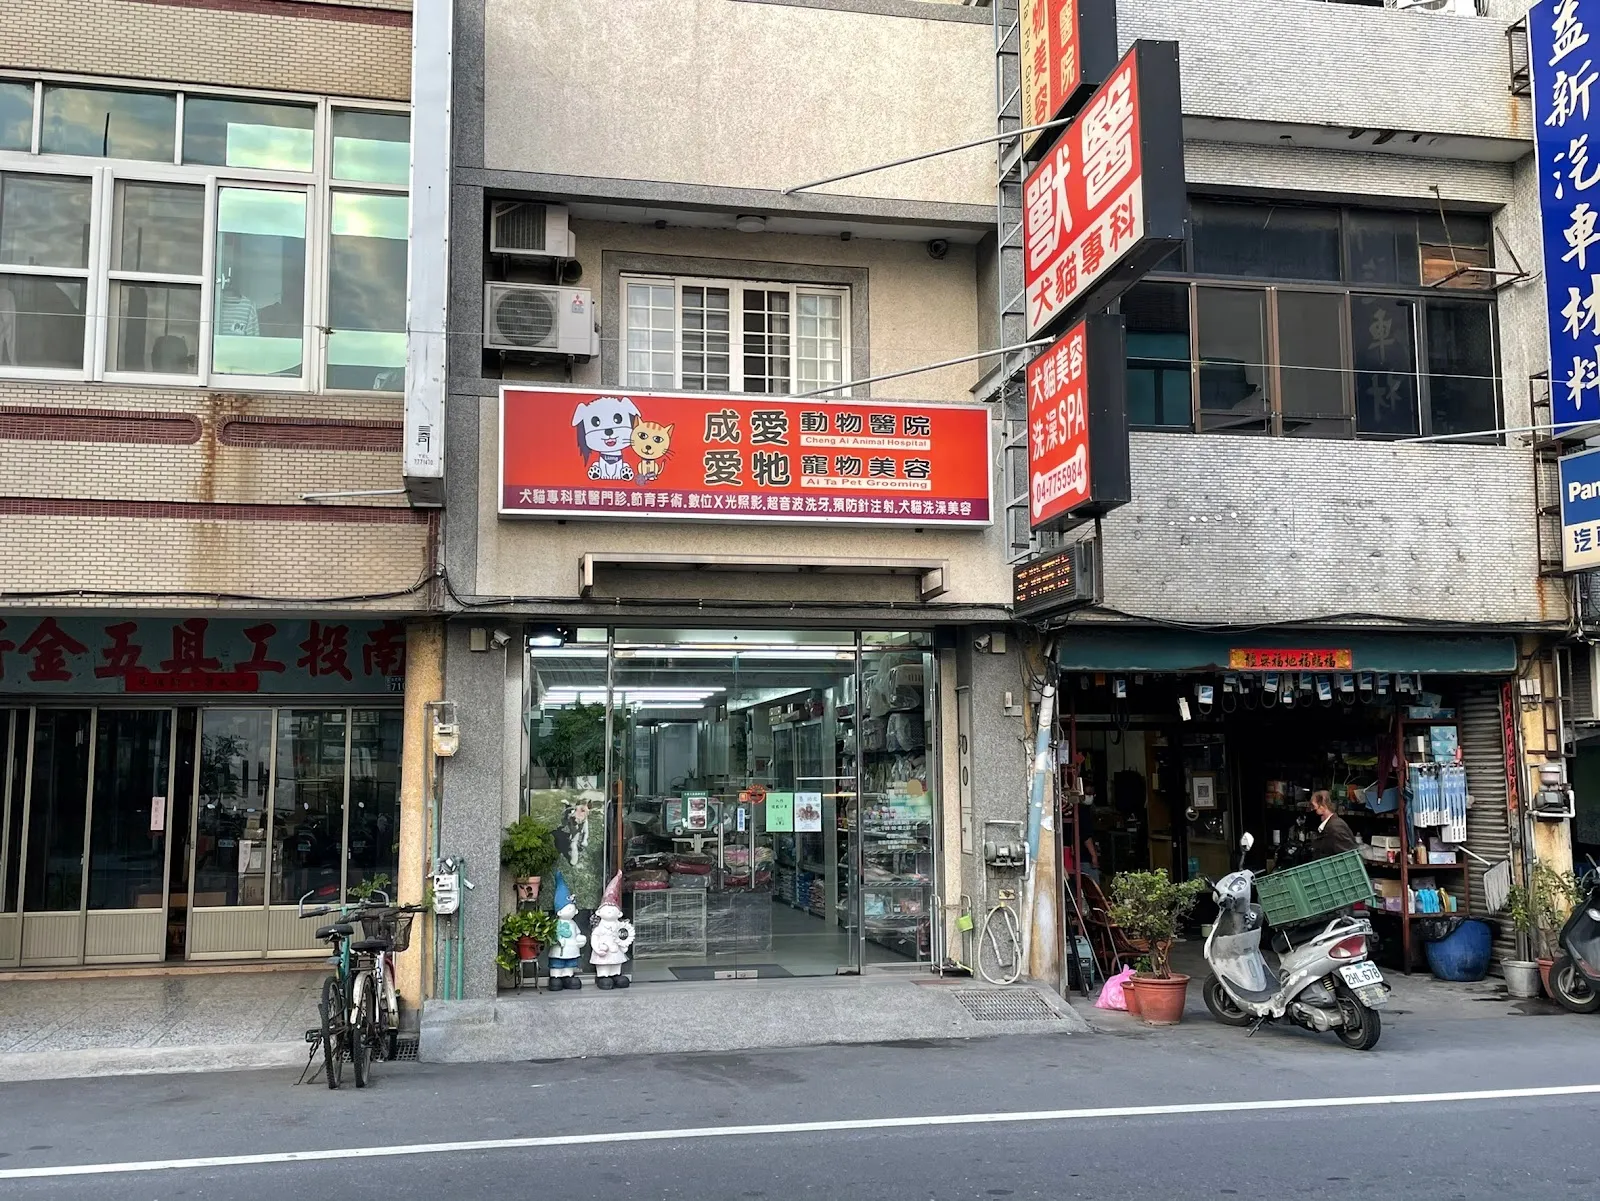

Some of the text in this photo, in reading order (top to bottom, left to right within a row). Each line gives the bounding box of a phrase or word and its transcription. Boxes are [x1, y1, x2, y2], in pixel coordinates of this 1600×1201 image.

[1027, 66, 1134, 272] 獸醫
[1032, 193, 1136, 327] 犬貓專科
[1031, 334, 1084, 412] 犬貓美容
[805, 436, 836, 446] Cheng
[852, 438, 885, 447] Animal
[887, 438, 927, 448] Hospital
[806, 477, 928, 490] Ai Ta Pet Grooming
[1036, 458, 1083, 504] 04-7755984
[1574, 526, 1600, 553] 汽
[0, 616, 406, 682] 南投工具五金
